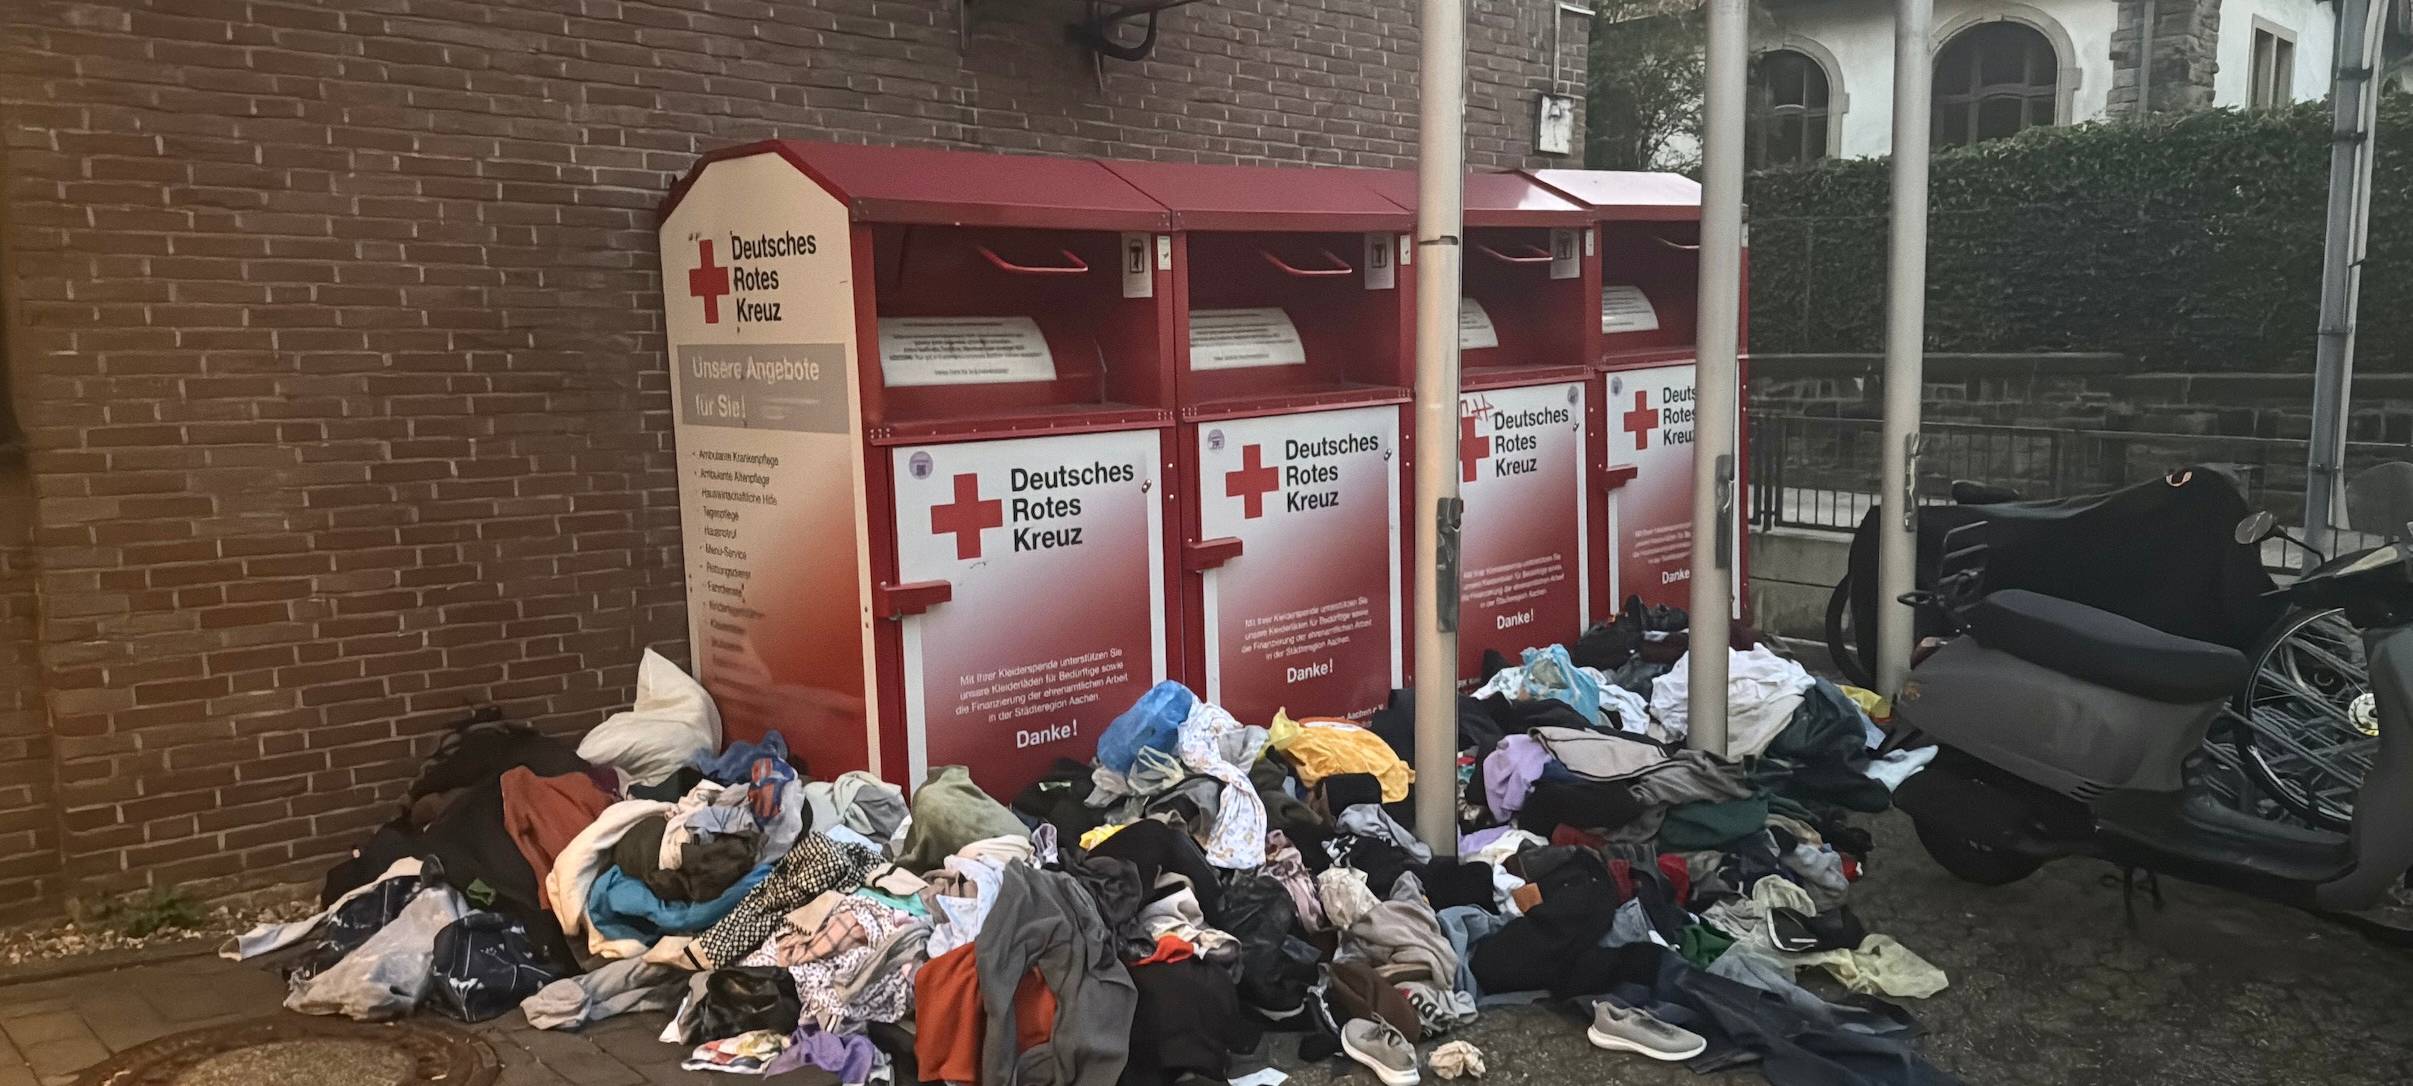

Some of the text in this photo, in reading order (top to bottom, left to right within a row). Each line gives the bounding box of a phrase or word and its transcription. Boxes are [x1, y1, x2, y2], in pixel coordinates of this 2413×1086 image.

[731, 231, 817, 260] Deutsches
[734, 267, 780, 292] Rotes
[737, 298, 782, 323] Kreuz
[692, 355, 820, 385] Unsere Angebote
[718, 394, 746, 419] Sie!
[1494, 406, 1569, 431] Deutsches
[1286, 434, 1379, 460] Deutsches
[1495, 434, 1537, 454] Rotes
[1663, 428, 1695, 446] Kreu
[1011, 461, 1134, 492] Deutsches
[1286, 464, 1339, 487] Rotes
[1496, 458, 1538, 478] Kreuz
[1012, 497, 1082, 522] Rotes
[1287, 491, 1339, 513] Kreuz
[1014, 527, 1083, 552] Kreuz
[1496, 608, 1534, 630] Danke!
[960, 674, 975, 687] Mit
[998, 659, 1058, 679] Kleiderspende
[1060, 650, 1109, 667] unterstützen
[1110, 647, 1123, 658] Sie
[1287, 657, 1334, 684] Danke!
[960, 661, 1124, 701] unsere Kleiderläden für Bedürftige sowie
[955, 672, 1129, 716] die Finanzierung der ehrenamtlichen Arbeit
[988, 714, 997, 723] in
[998, 710, 1013, 721] der
[1014, 699, 1068, 717] Städteregion
[1016, 718, 1078, 749] Danke!
